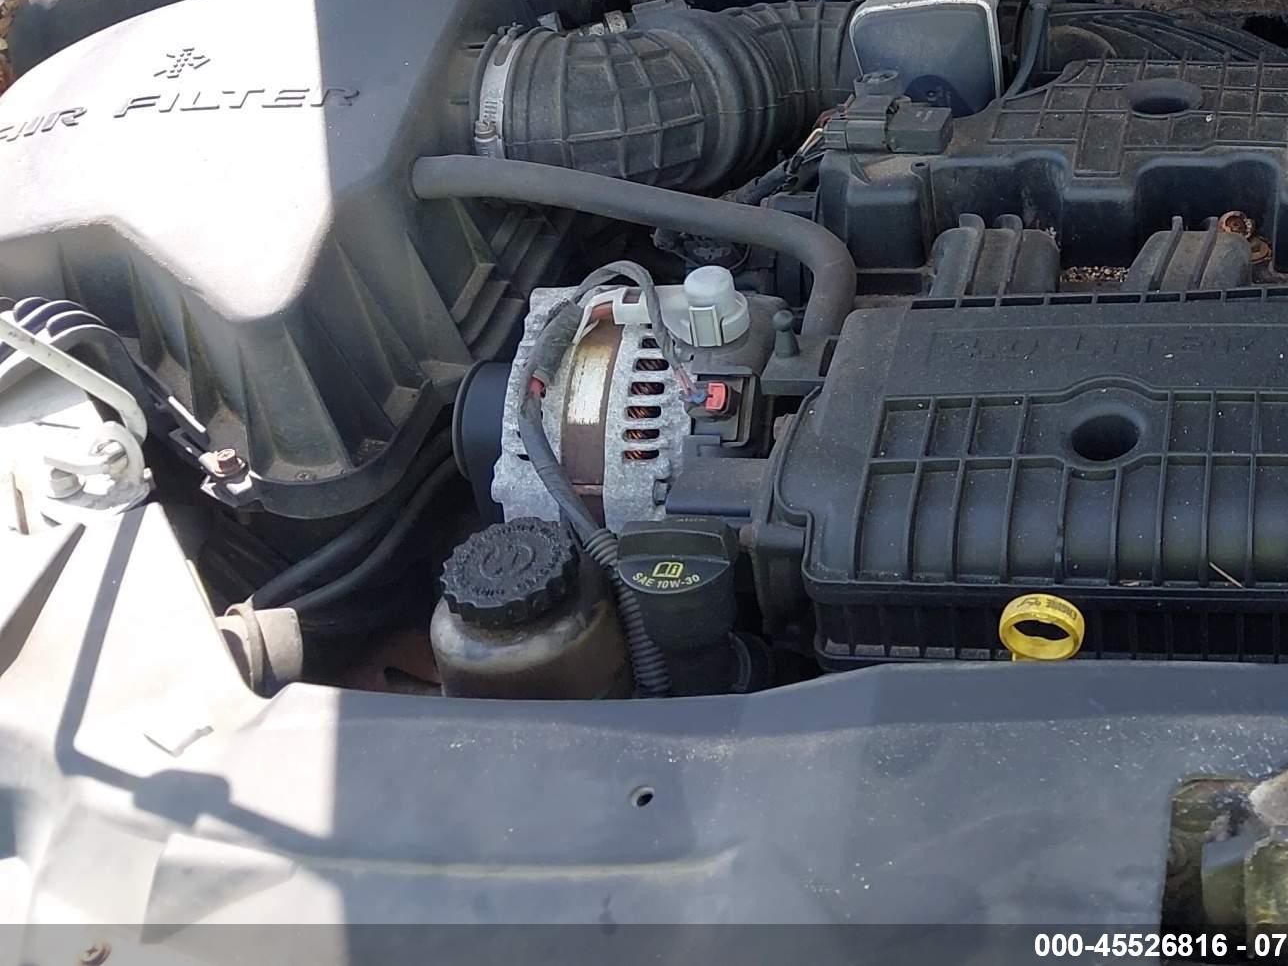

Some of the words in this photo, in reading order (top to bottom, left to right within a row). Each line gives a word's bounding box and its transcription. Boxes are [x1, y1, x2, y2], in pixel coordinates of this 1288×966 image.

[113, 88, 361, 118] FILTER
[632, 572, 655, 587] SAE
[657, 574, 700, 589] 10W-30
